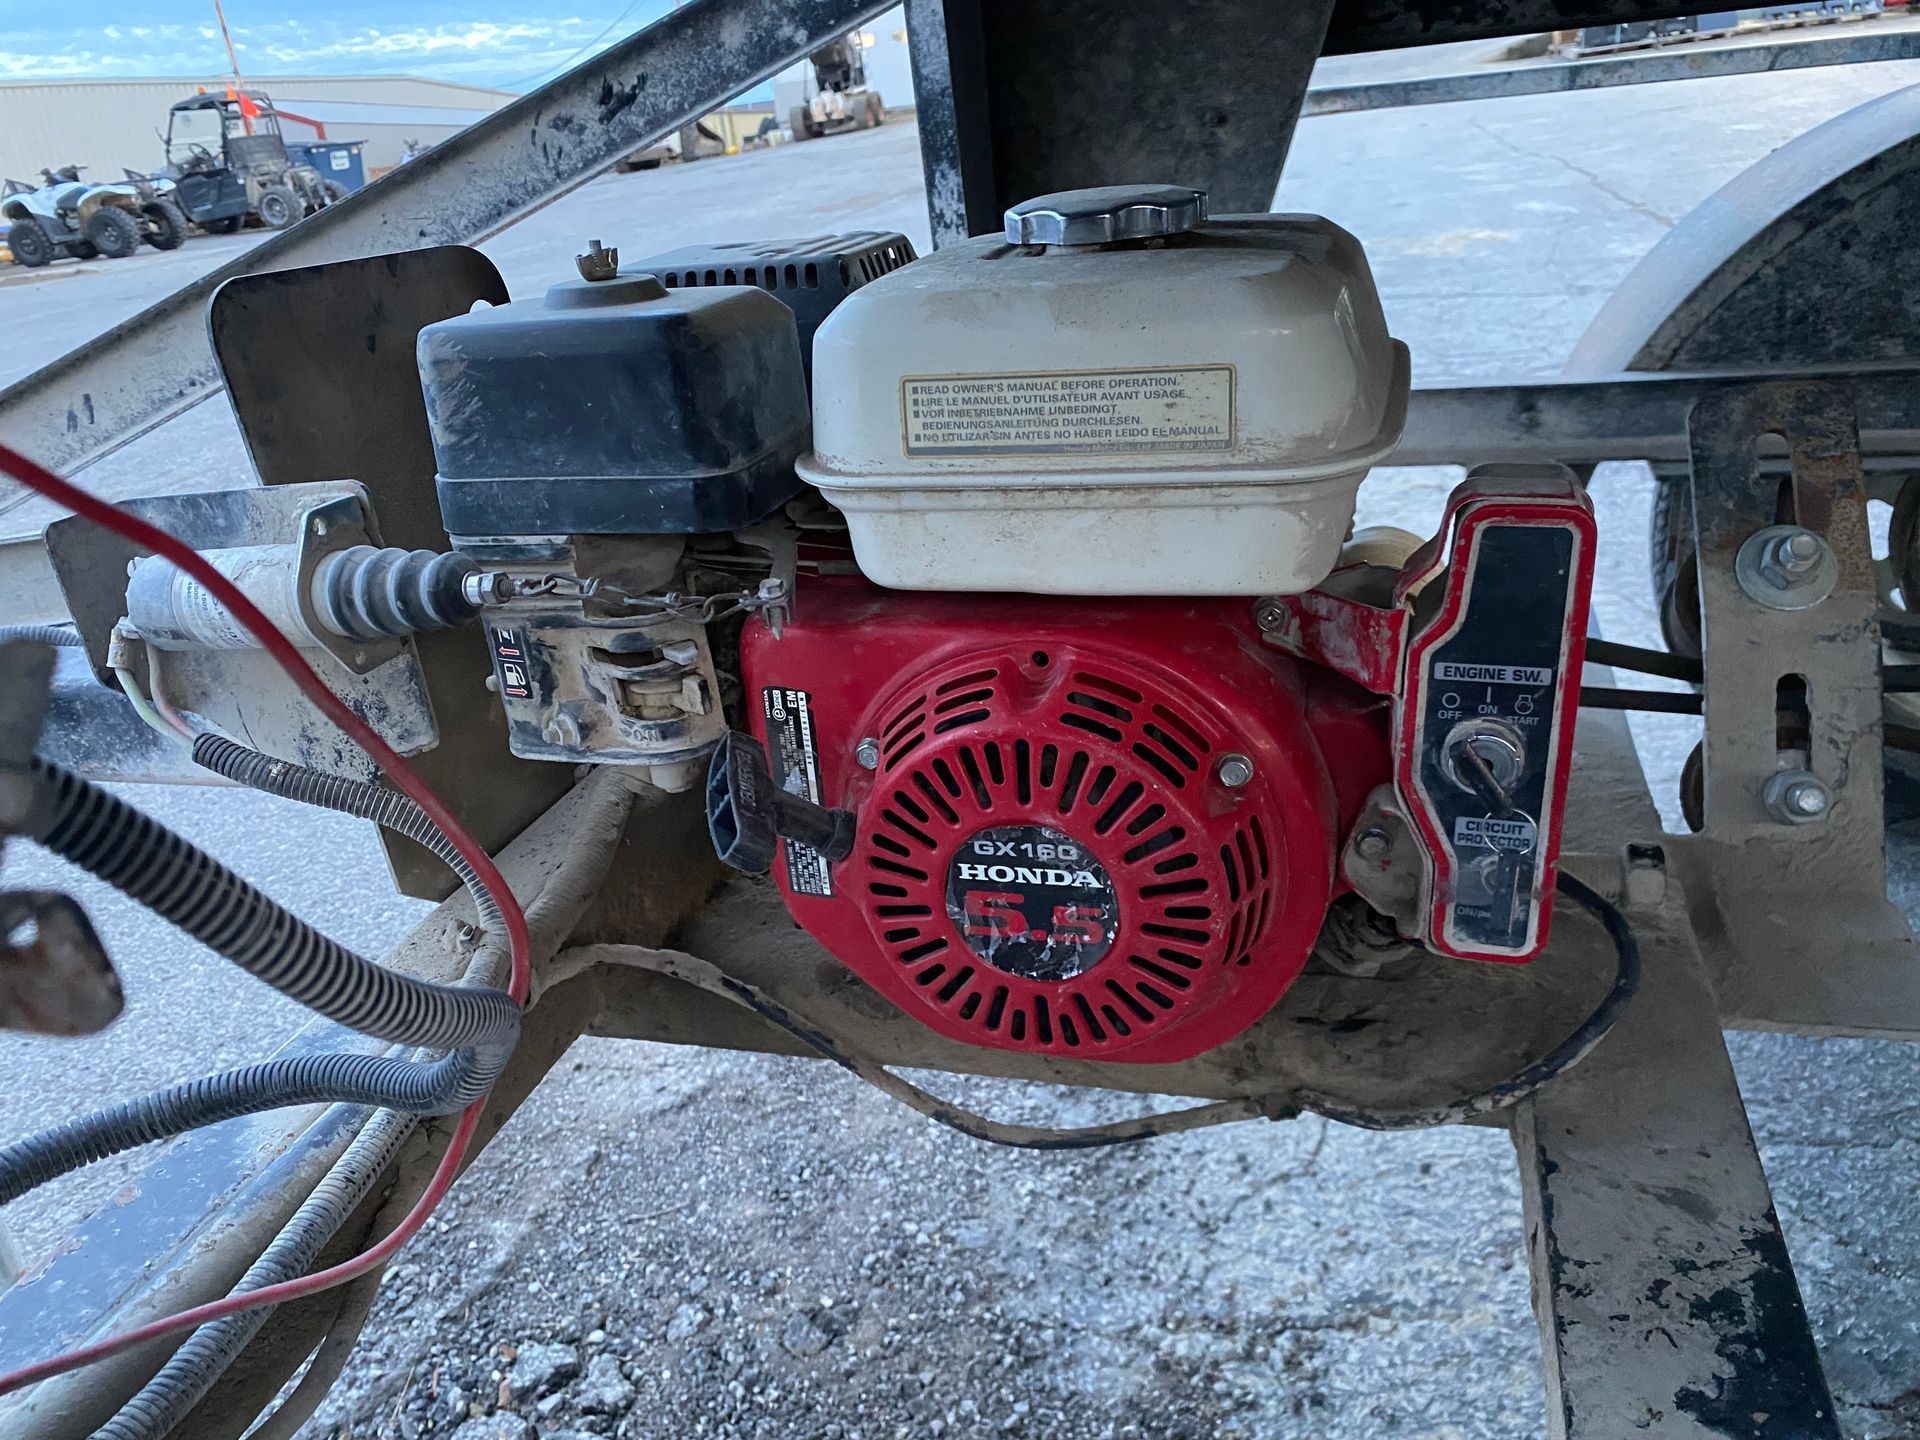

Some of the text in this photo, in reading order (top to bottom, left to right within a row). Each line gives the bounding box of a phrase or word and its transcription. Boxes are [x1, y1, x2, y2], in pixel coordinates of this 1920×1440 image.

[920, 377, 1180, 395] READ OWNER'S MANUAL BEFORE OPERATION.
[921, 389, 1188, 407] LIRE LE MANUEL D'UTILISATEUR AVANT USAGE.
[922, 409, 945, 419] VOR
[947, 407, 1046, 418] INBETRIEBNAHME
[922, 415, 1143, 430] BEDIENUNGSANLEITUNG DURCHLESEN.
[923, 433, 939, 443] NO
[942, 431, 990, 442] UTILIZAR
[992, 430, 1011, 441] SIN
[1014, 430, 1051, 440] ANTES
[1053, 429, 1071, 439] NO
[1074, 428, 1112, 438] HABER
[1115, 427, 1149, 437] LEIDO
[1443, 665, 1544, 682] ENGINE SW.
[1437, 709, 1463, 720] OFF
[1478, 704, 1499, 715] ON
[1506, 716, 1540, 726] START
[1465, 821, 1526, 835] CIRCUIT
[1456, 833, 1531, 849] PROTECTOR
[957, 863, 1104, 888] HONDA
[964, 890, 1105, 944] 5.5
